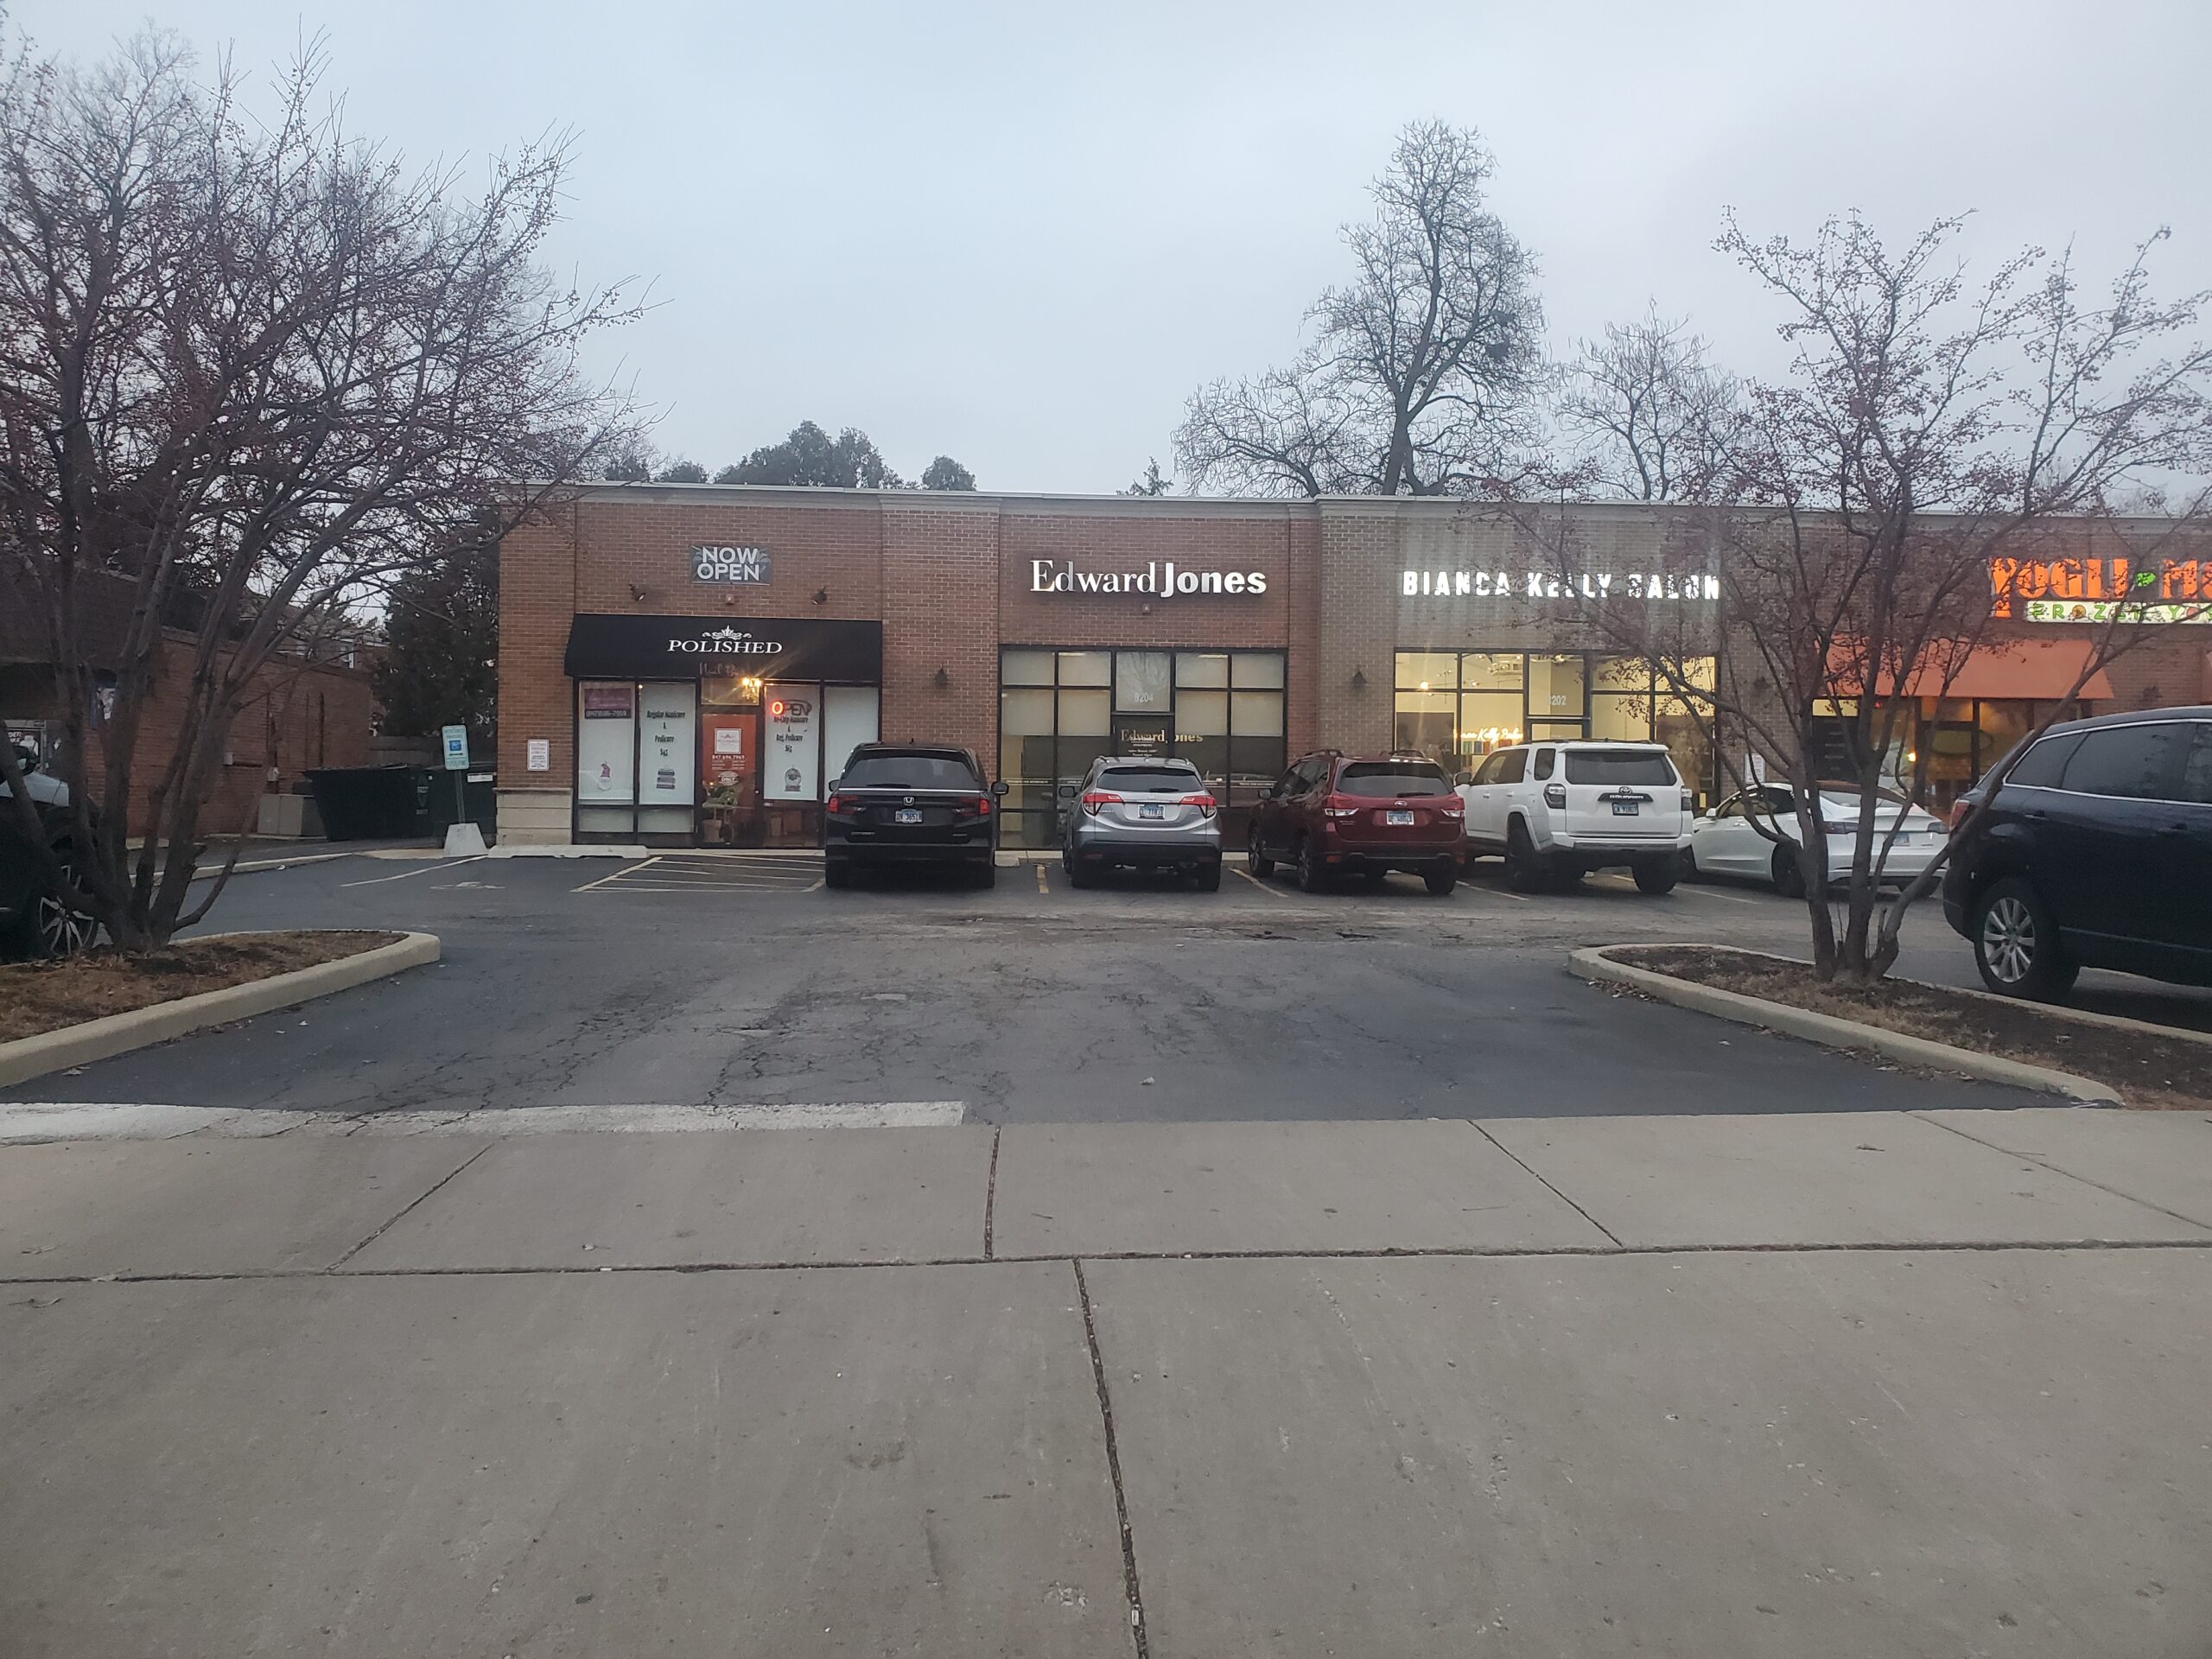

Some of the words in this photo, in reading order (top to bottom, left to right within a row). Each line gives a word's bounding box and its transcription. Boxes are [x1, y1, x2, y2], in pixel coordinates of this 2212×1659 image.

[702, 546, 758, 563] NOW
[697, 563, 759, 581] OPEN
[1030, 560, 1158, 592] Edward
[1160, 563, 1267, 597] Jones
[1402, 570, 1511, 596] BIANCA
[1528, 572, 1611, 598] KELLY
[1629, 574, 1719, 599] SALON
[667, 639, 783, 654] POLISHED
[664, 710, 686, 719] Manicure
[772, 701, 810, 716] OPEN
[654, 734, 675, 743] Pedicure
[1120, 729, 1166, 743] Edward
